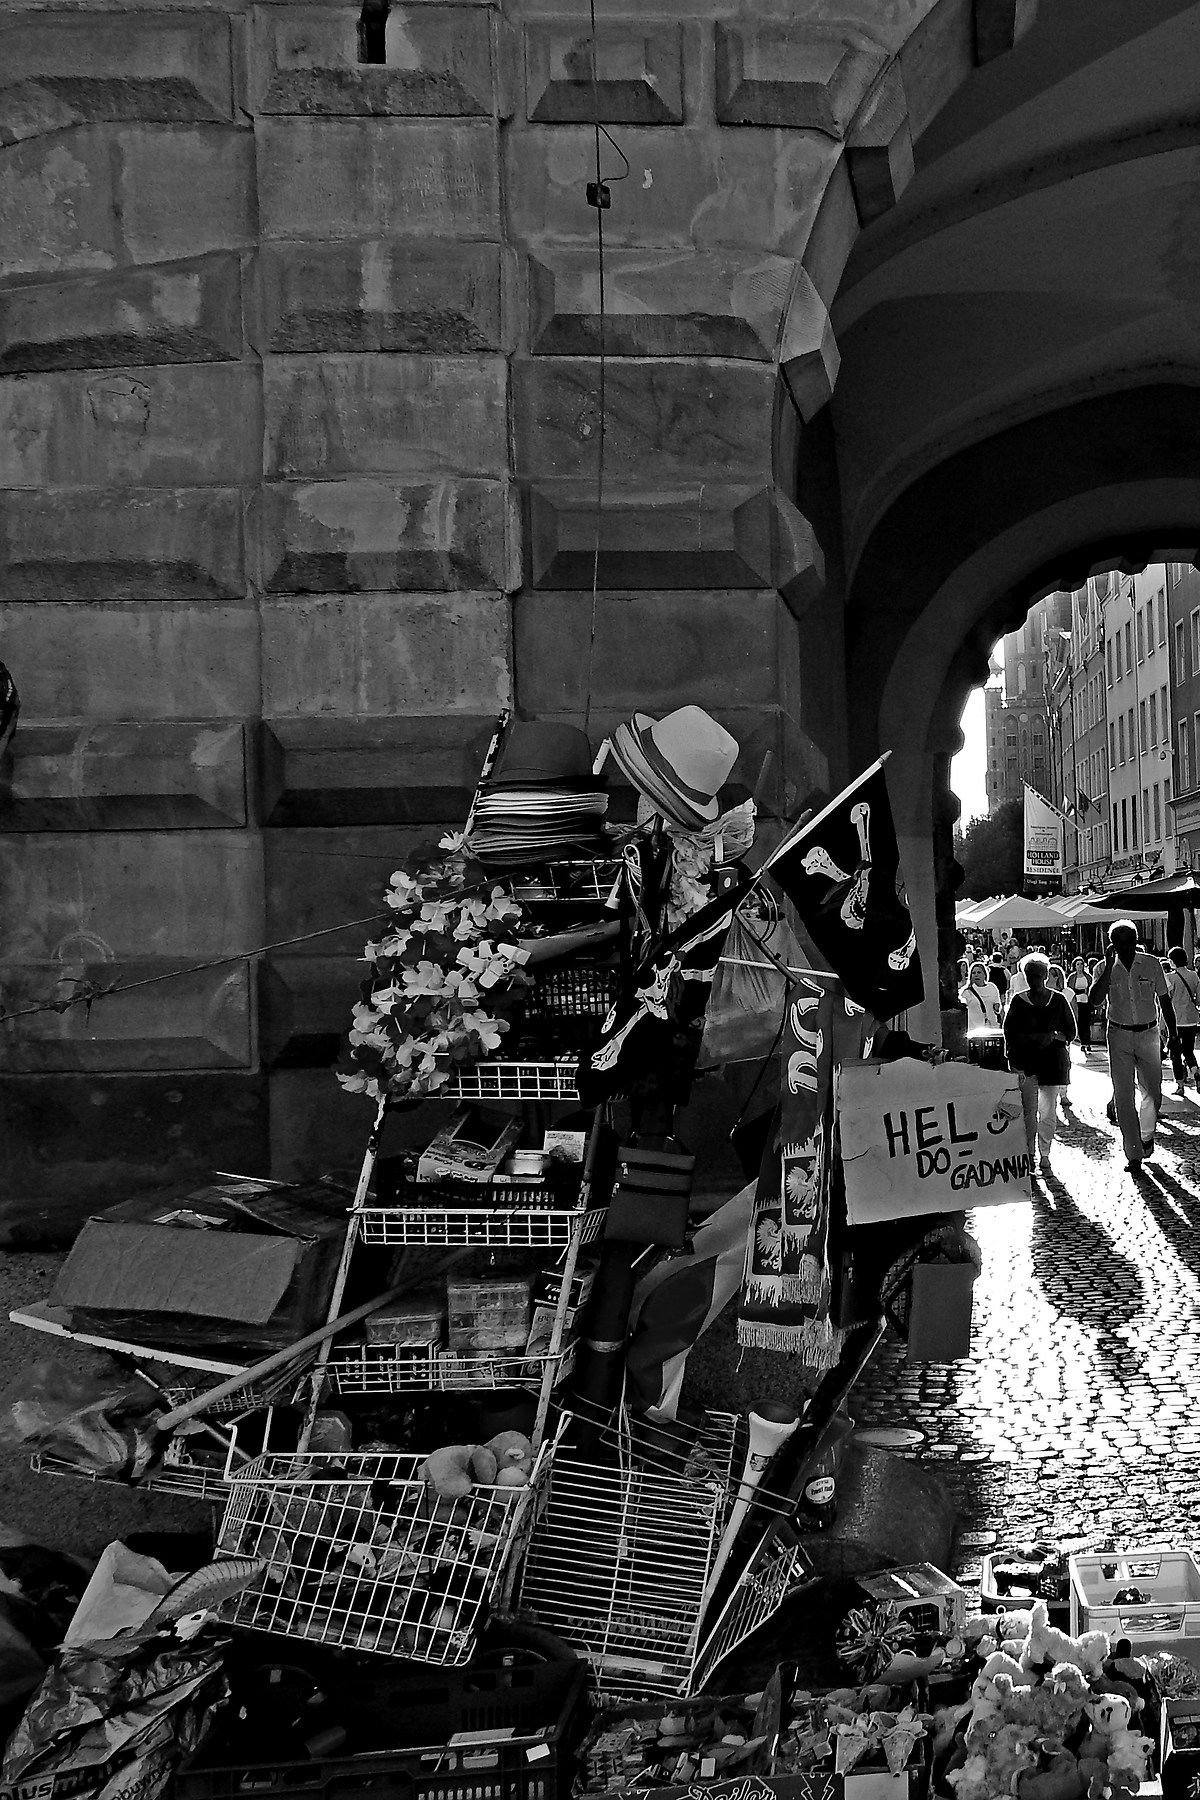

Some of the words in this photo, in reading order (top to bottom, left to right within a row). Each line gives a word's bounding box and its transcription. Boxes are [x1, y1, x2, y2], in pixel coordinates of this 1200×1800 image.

[1027, 851, 1060, 859] HOLLAND
[1026, 866, 1060, 874] RESIDENCE
[883, 1102, 979, 1158] HEL
[950, 1153, 1033, 1190] GADANIA
